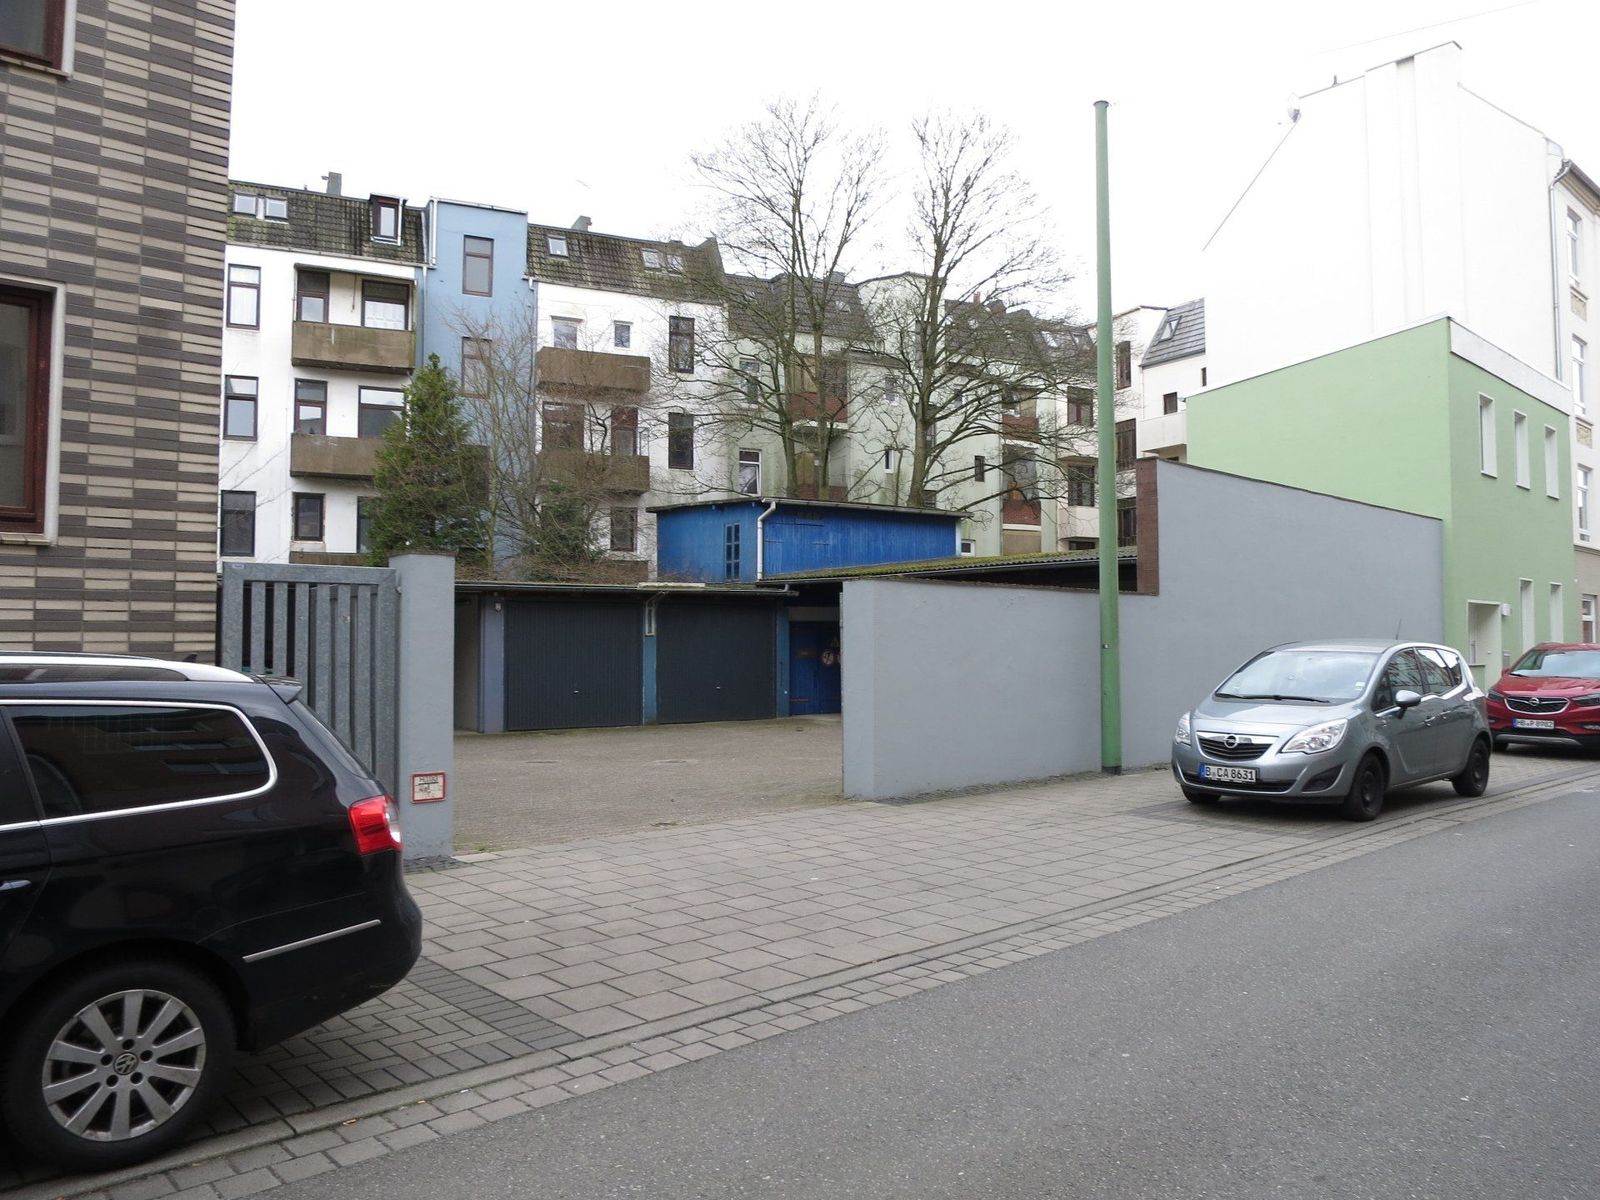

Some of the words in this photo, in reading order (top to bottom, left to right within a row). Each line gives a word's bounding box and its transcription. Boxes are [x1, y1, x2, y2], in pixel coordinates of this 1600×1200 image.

[1205, 766, 1211, 776] B
[1217, 768, 1229, 778] CA
[1231, 769, 1254, 780] 8631
